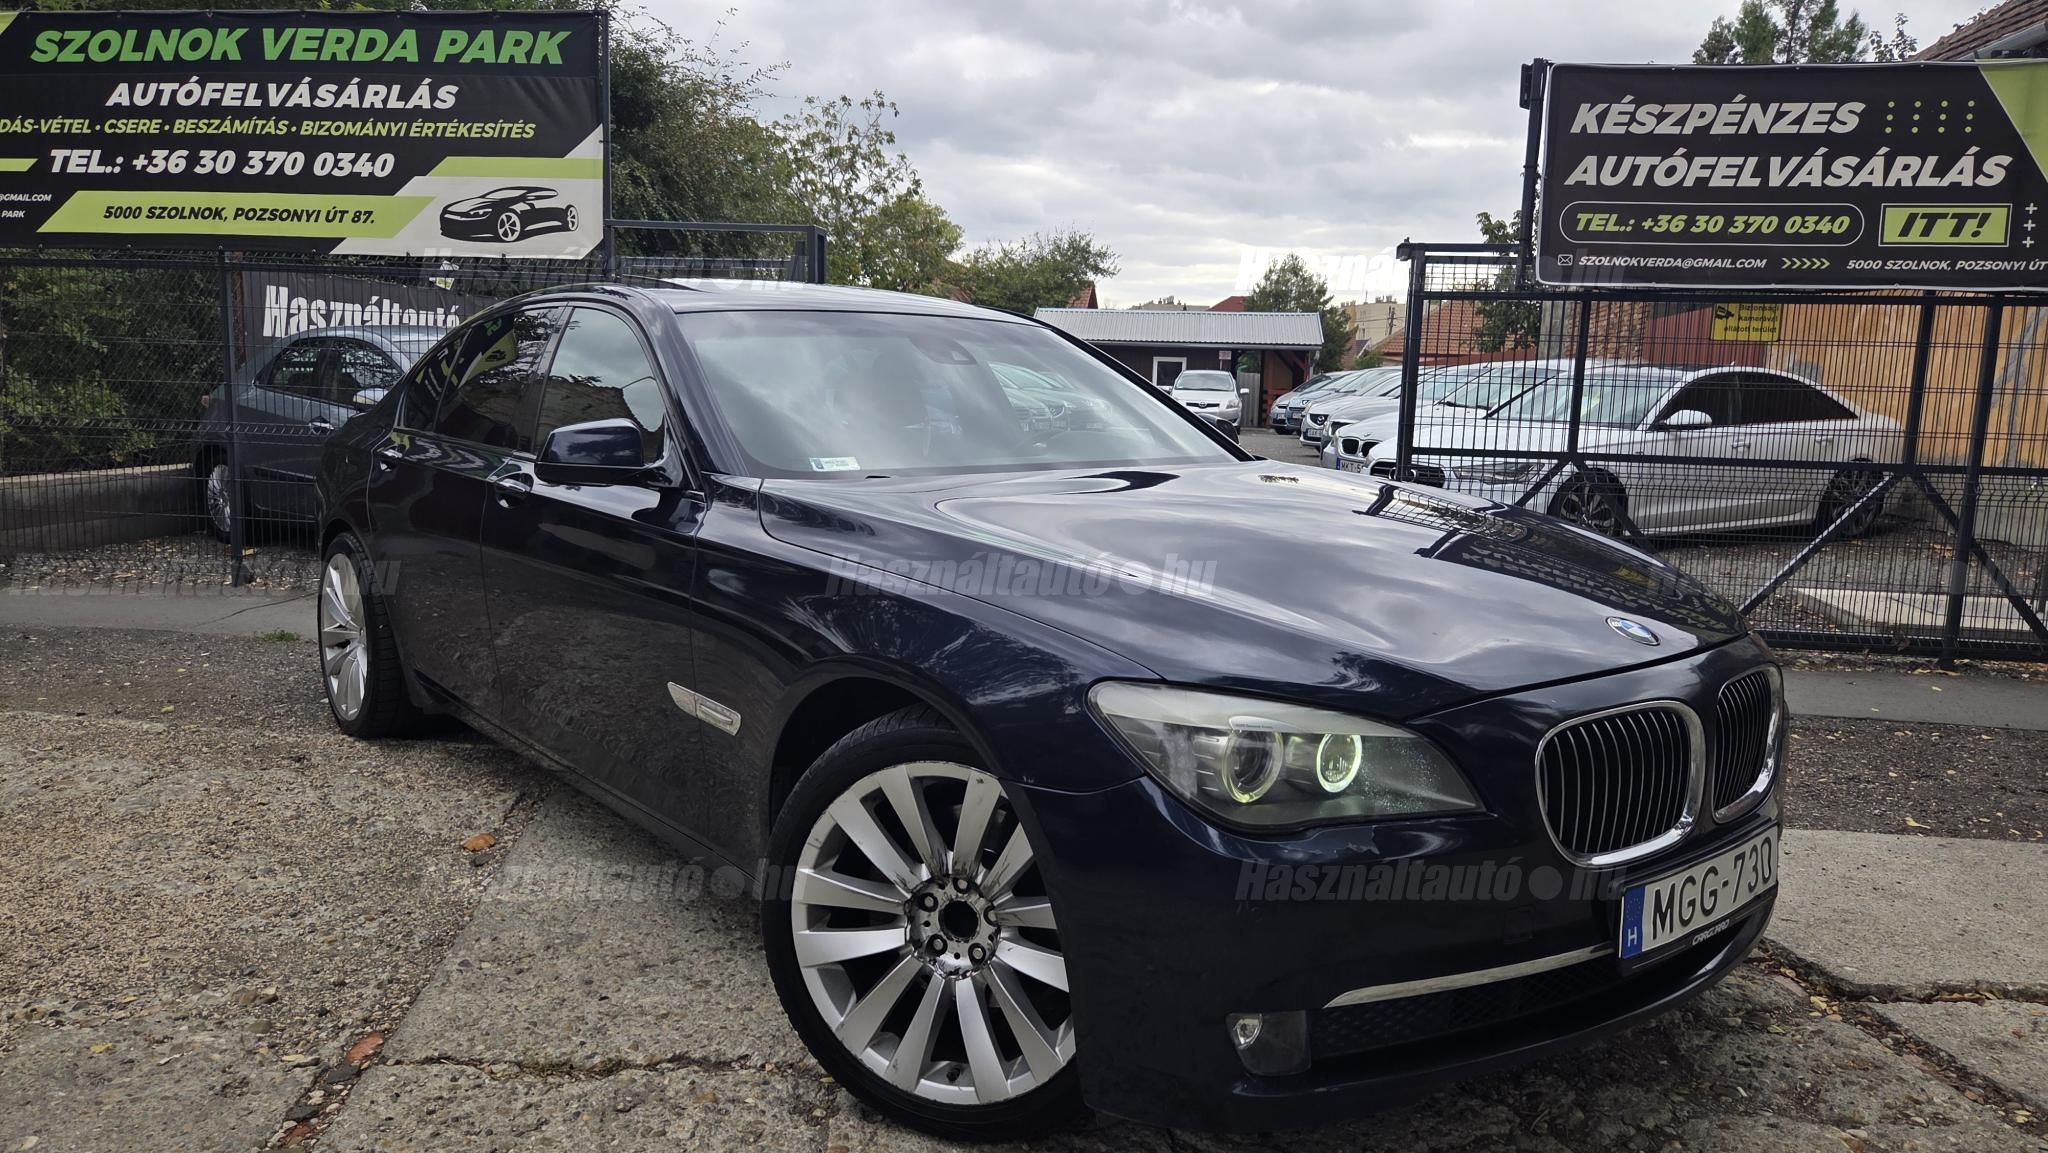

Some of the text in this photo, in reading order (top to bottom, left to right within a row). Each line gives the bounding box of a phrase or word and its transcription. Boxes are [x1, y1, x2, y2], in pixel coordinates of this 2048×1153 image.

[30, 27, 572, 64] SZOLNOK VERDA PARK
[105, 76, 459, 109] AUTÓFELVÁSÁRLÁS
[1570, 94, 1866, 134] KÉSZPÉNZES
[104, 119, 161, 134] CSERE
[173, 117, 289, 135] BESZÁMÍTÁS
[300, 118, 406, 137] BIZOMÁNYI
[409, 119, 536, 138] ÉRTÉKESÍTÉS
[50, 149, 395, 177] TEL.: +36 30 370 0340
[1564, 146, 2013, 187] AUTÓFELVÁSÁRLÁS
[2, 210, 26, 218] PARK
[103, 206, 375, 224] 5000 SZOLNOK, POZSONYI ÚT 87.
[1576, 213, 1850, 234] TEL.: +36 30 370 0340
[1898, 212, 1992, 238] ITT!
[1578, 256, 1767, 269] SZOLNOKVERDA@GMAIL.COM
[1846, 258, 2048, 272] 5000 SZOLNOK, POZSONYI ÚT
[1652, 836, 1772, 940] MGG-730
[1627, 926, 1638, 947] H
